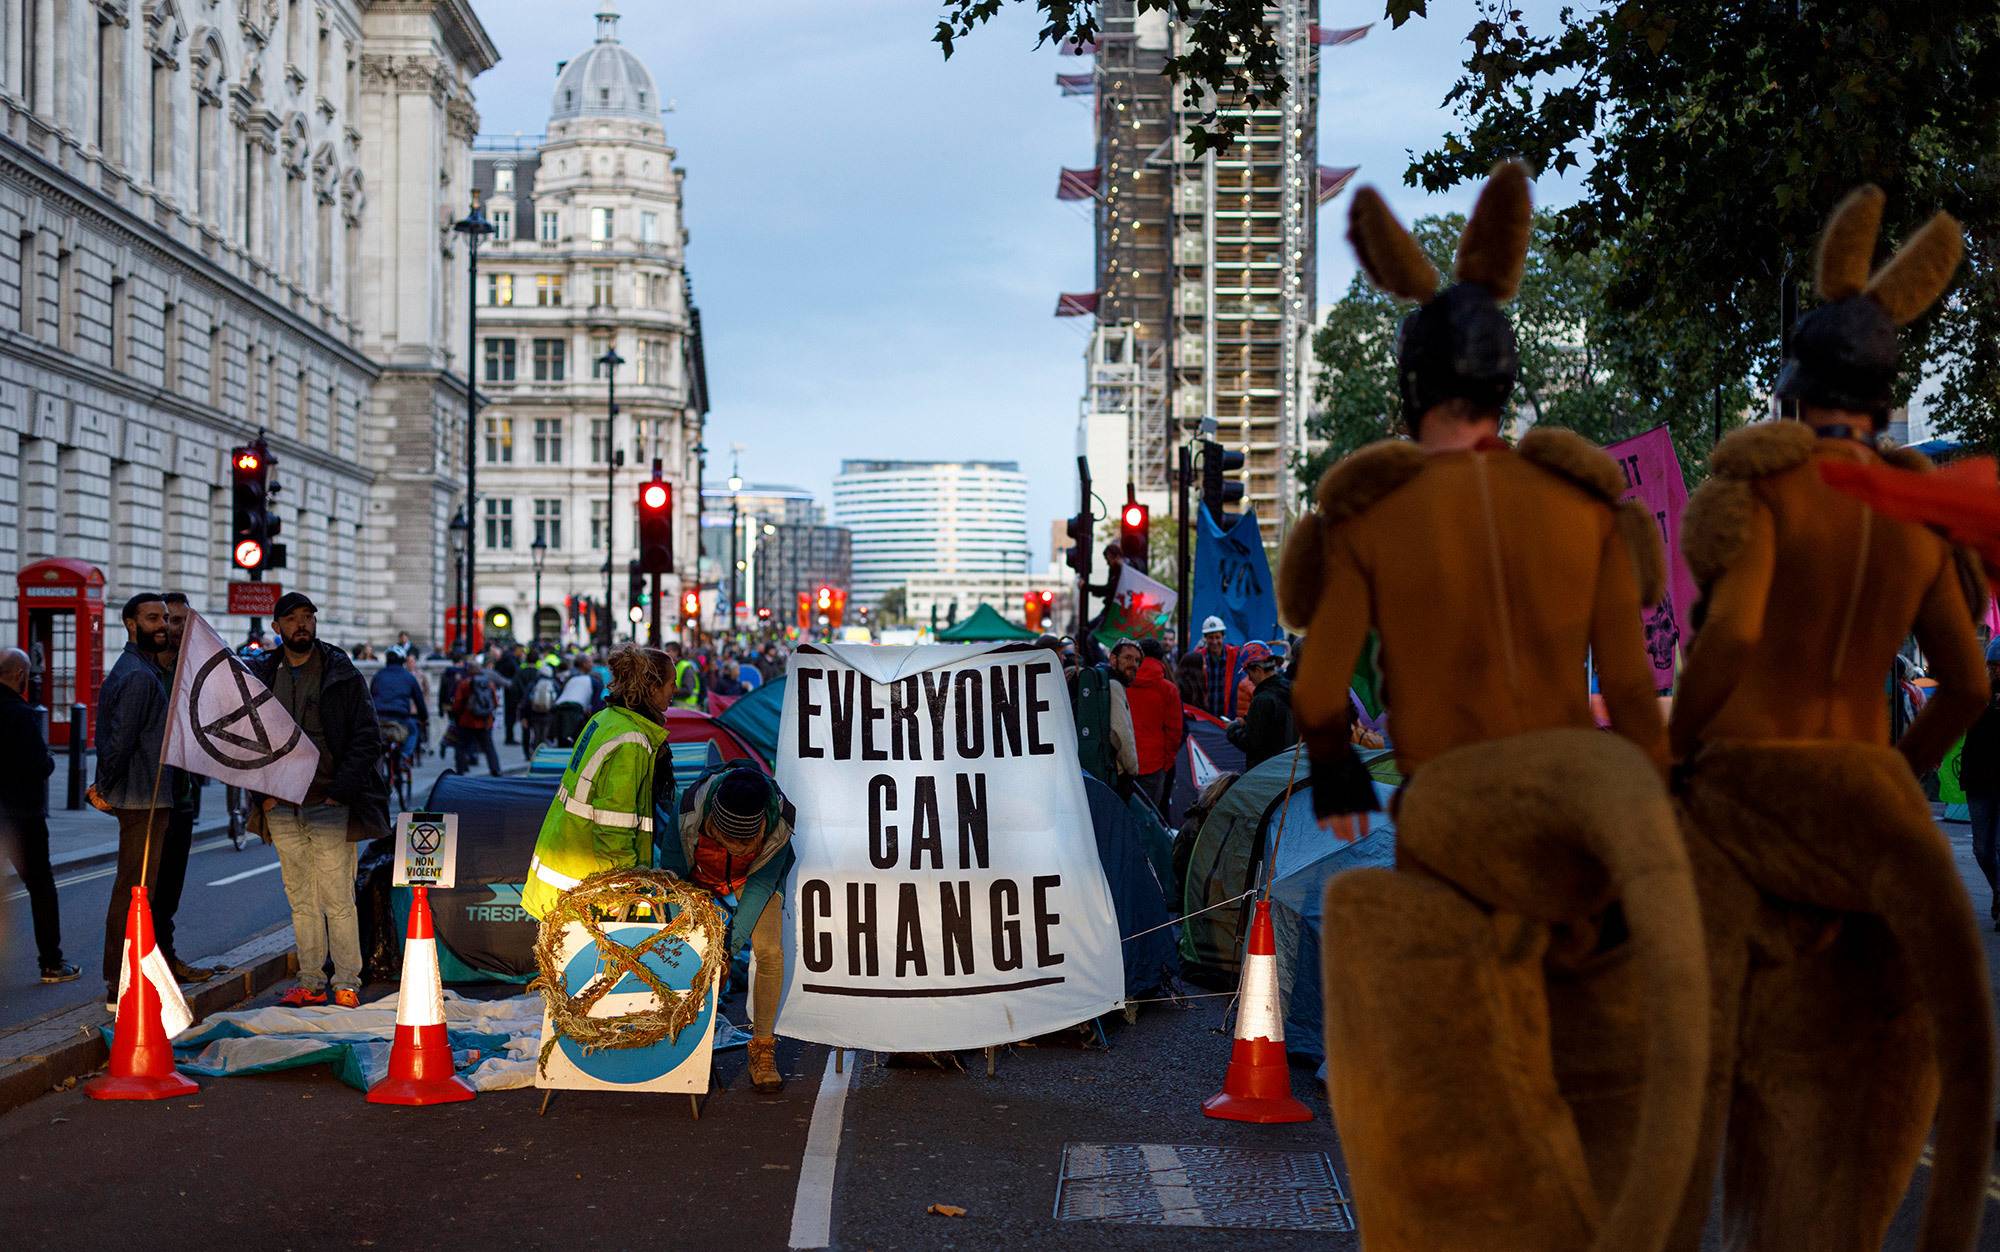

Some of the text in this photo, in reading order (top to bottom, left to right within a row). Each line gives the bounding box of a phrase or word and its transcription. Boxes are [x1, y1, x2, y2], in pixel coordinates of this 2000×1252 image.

[797, 662, 1055, 761] EVERYONE
[415, 856, 434, 867] NON
[868, 772, 990, 870] CAN
[406, 867, 442, 877] VIOLENT
[801, 874, 1066, 978] CHANGE
